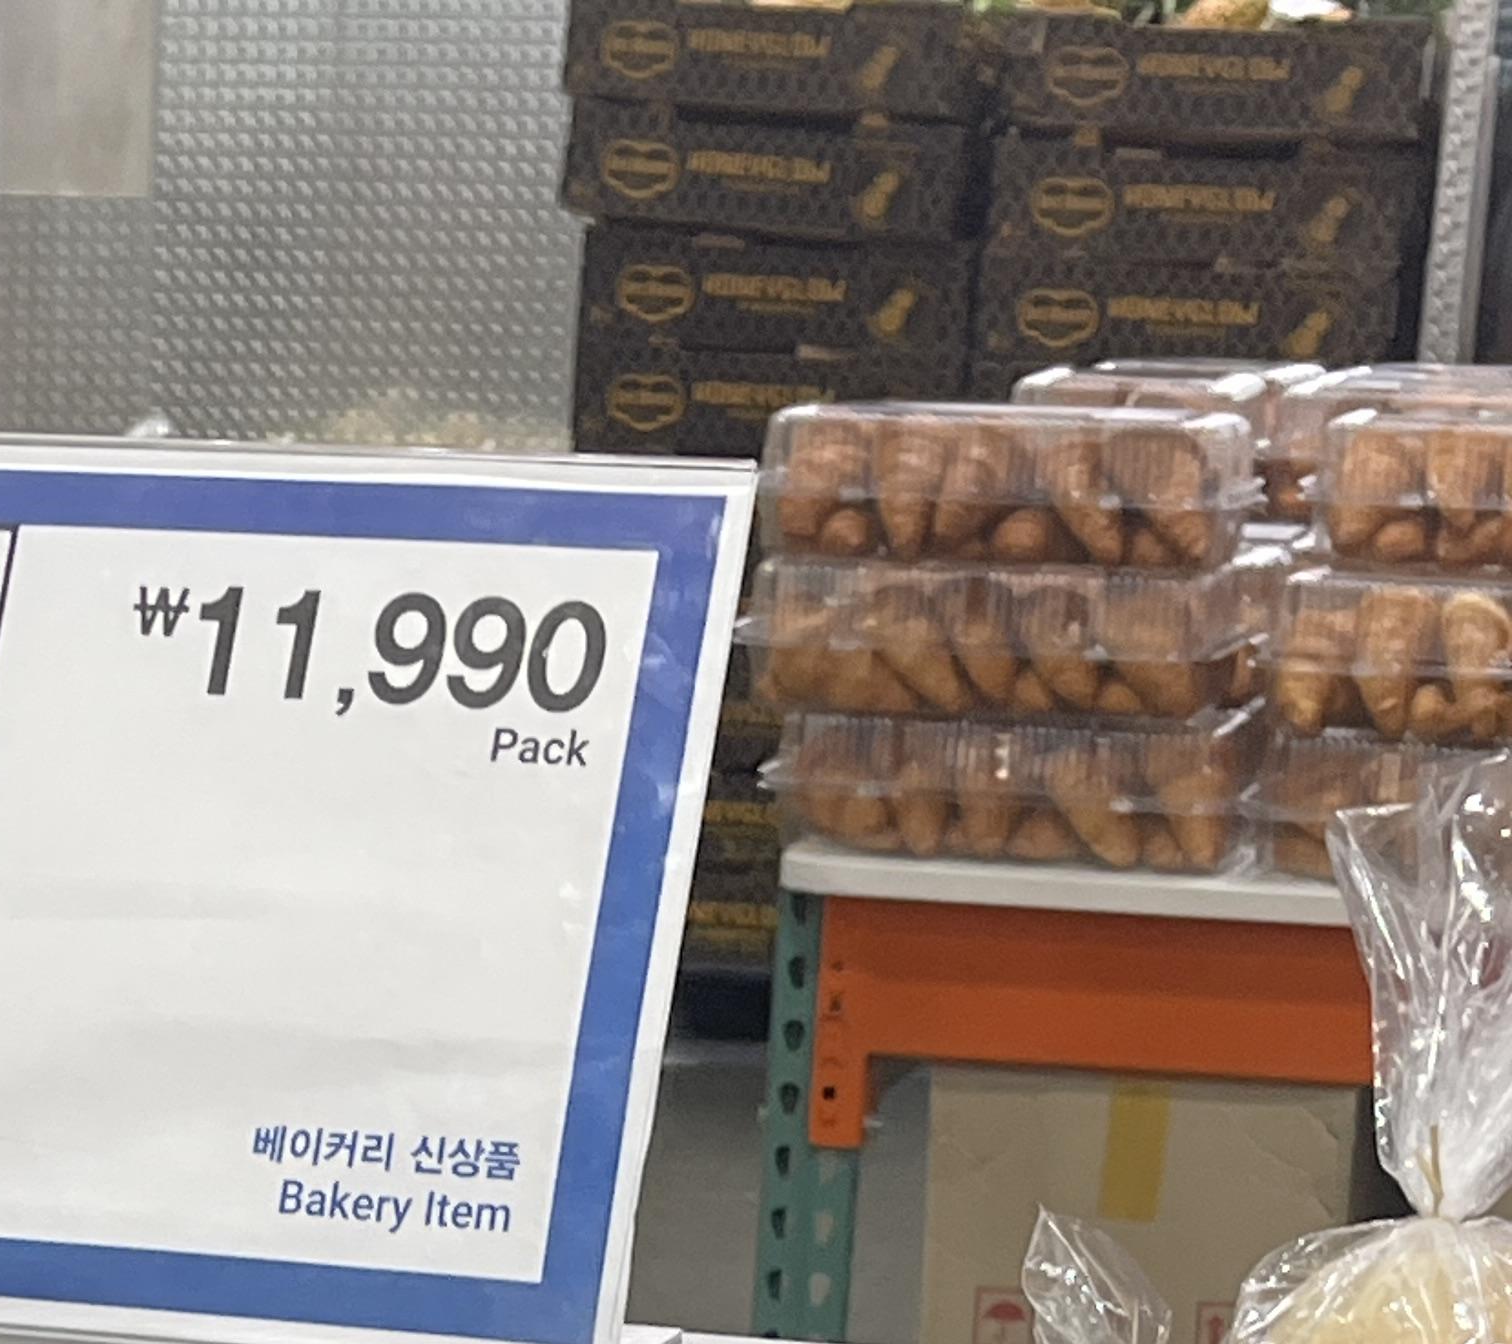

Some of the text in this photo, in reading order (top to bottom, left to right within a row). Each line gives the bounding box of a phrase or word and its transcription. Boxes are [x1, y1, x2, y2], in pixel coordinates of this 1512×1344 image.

[489, 727, 590, 768] Pack
[252, 1125, 521, 1181] 베이커리 신상품
[277, 1179, 511, 1234] Bakery Item
